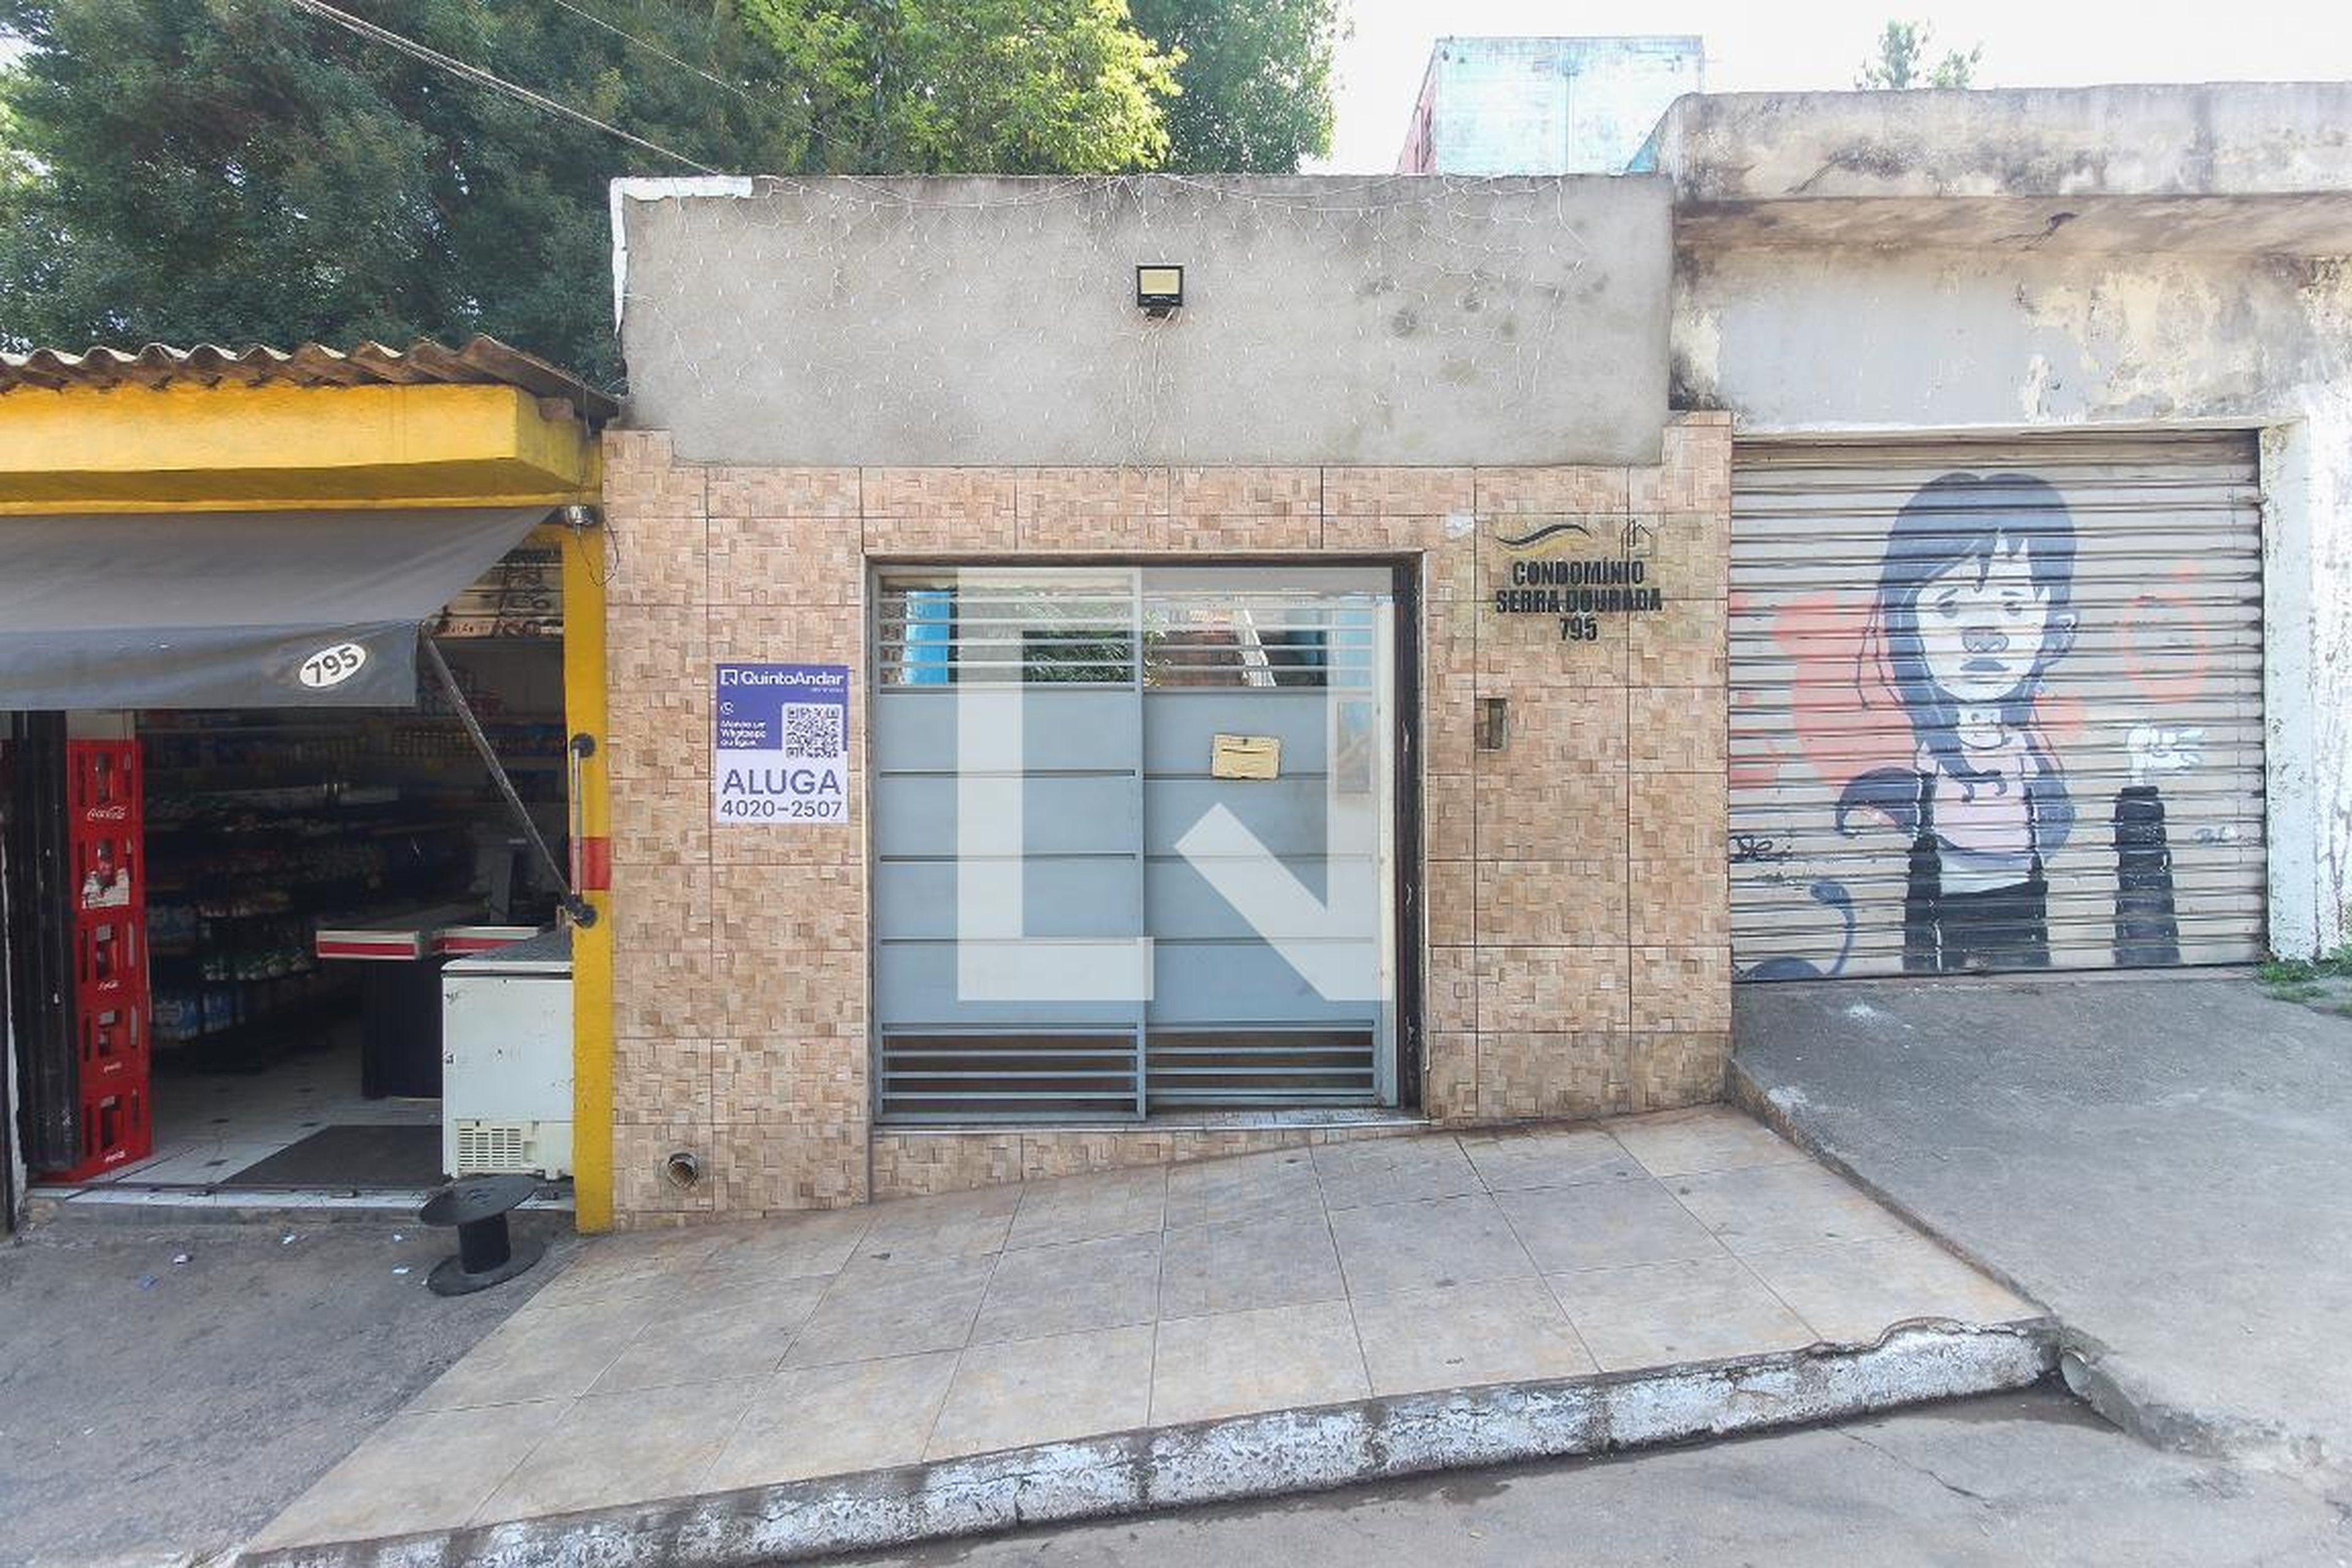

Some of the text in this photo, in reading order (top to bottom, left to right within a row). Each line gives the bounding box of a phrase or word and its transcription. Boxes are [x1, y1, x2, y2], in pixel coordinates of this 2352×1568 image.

[1512, 556, 1645, 586] CONDOMÍNIO
[1496, 587, 1662, 613] SERRA DOURADA
[1559, 617, 1598, 641] 795
[306, 646, 358, 684] 795
[741, 671, 844, 685] QuintoAndar
[722, 769, 842, 796] ALUGA
[721, 800, 842, 817] 4020-2507
